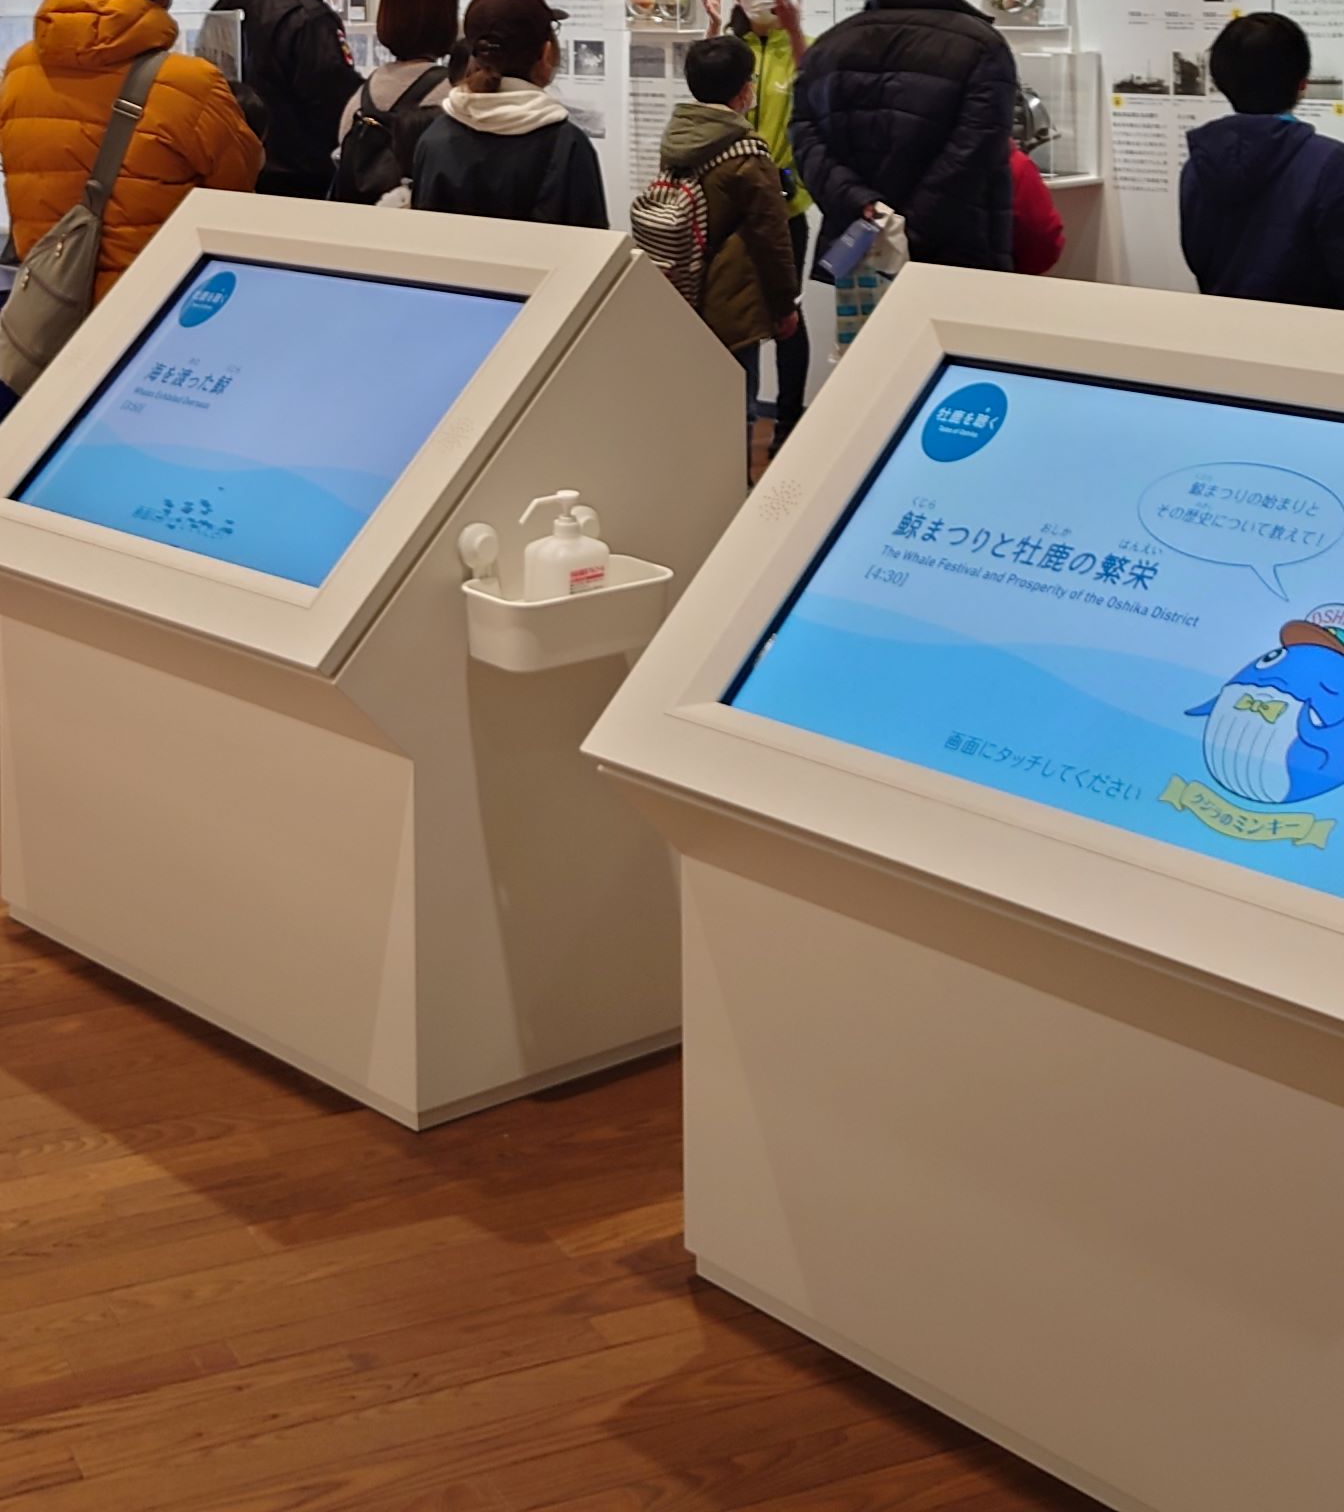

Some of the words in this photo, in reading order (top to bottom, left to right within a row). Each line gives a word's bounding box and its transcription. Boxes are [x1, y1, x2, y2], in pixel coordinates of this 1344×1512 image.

[145, 361, 233, 395] 海を渡った鯨
[1187, 480, 1321, 518] 鯨まつりの始まりと
[1039, 522, 1073, 538] おしか
[1118, 539, 1164, 557] はんえい
[891, 510, 1160, 592] 鯨まつりと牡鹿の繁栄
[864, 565, 910, 588] [4:30]
[881, 544, 902, 560] The
[903, 548, 936, 568] Whale
[937, 556, 982, 579] Festival
[982, 568, 1004, 585] and
[1006, 573, 1067, 600] Prosperity
[1069, 587, 1083, 602] of
[1084, 590, 1105, 606] the
[1107, 595, 1149, 618] Oshika
[1151, 603, 1200, 628] District
[942, 729, 1143, 802] 画面にタッチしてください
[1190, 791, 1301, 837] クジラのミンキー
